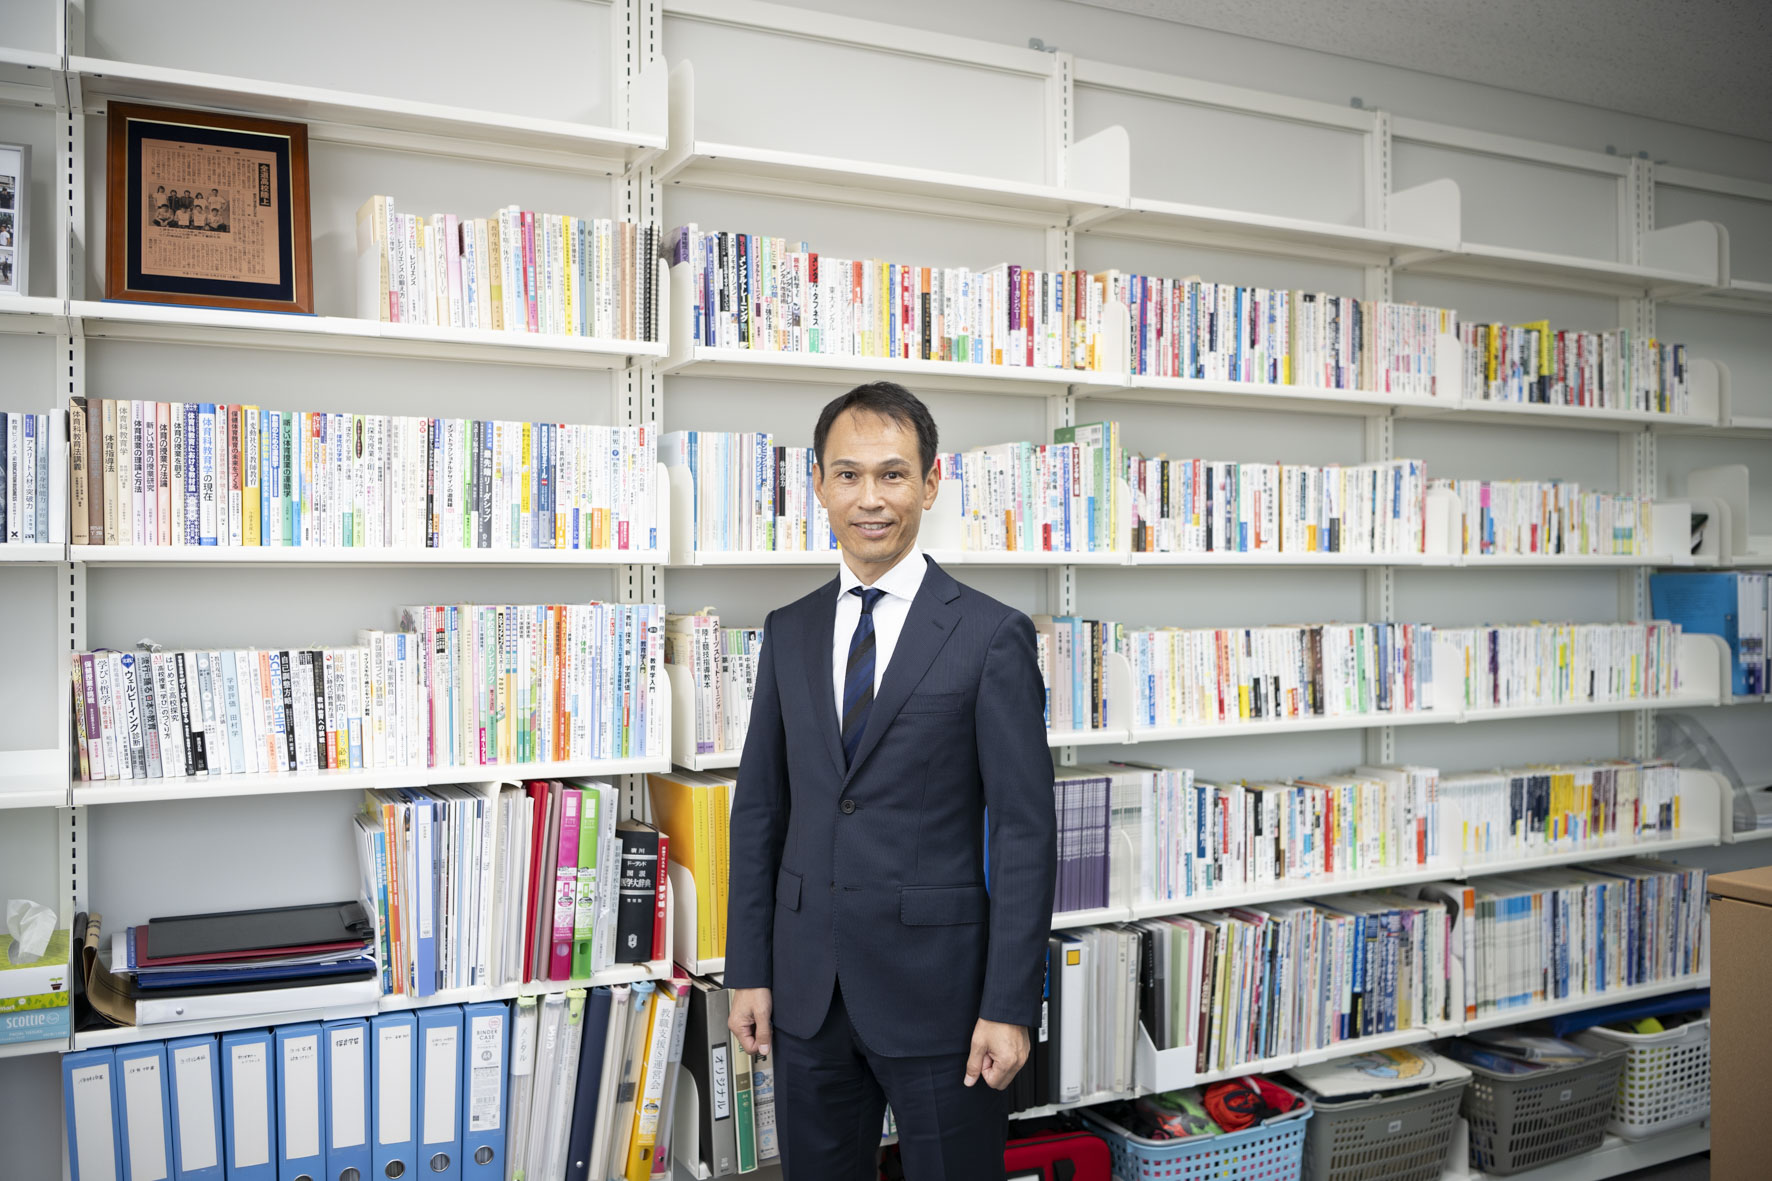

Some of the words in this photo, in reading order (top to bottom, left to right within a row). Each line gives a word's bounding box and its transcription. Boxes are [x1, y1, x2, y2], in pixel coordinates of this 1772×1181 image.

[739, 256, 749, 322] メンタルトレーニング
[72, 410, 83, 471] 体育科教育法講義
[104, 434, 115, 473] 体育指導法
[118, 407, 129, 456] 体育科教育学
[133, 420, 143, 493] 体育授業の理論と方法
[145, 421, 155, 492] 新しい体育の授業研究
[159, 424, 168, 488] 体育の授業方法論
[202, 417, 214, 502] 体育科教育学の現在
[97, 658, 111, 706] 学びの哲学
[124, 669, 141, 747] ウェルビーイング診断
[165, 656, 180, 723] はじめての高校探究
[273, 704, 286, 735] SHIFT
[6, 1014, 46, 1029] scottie
